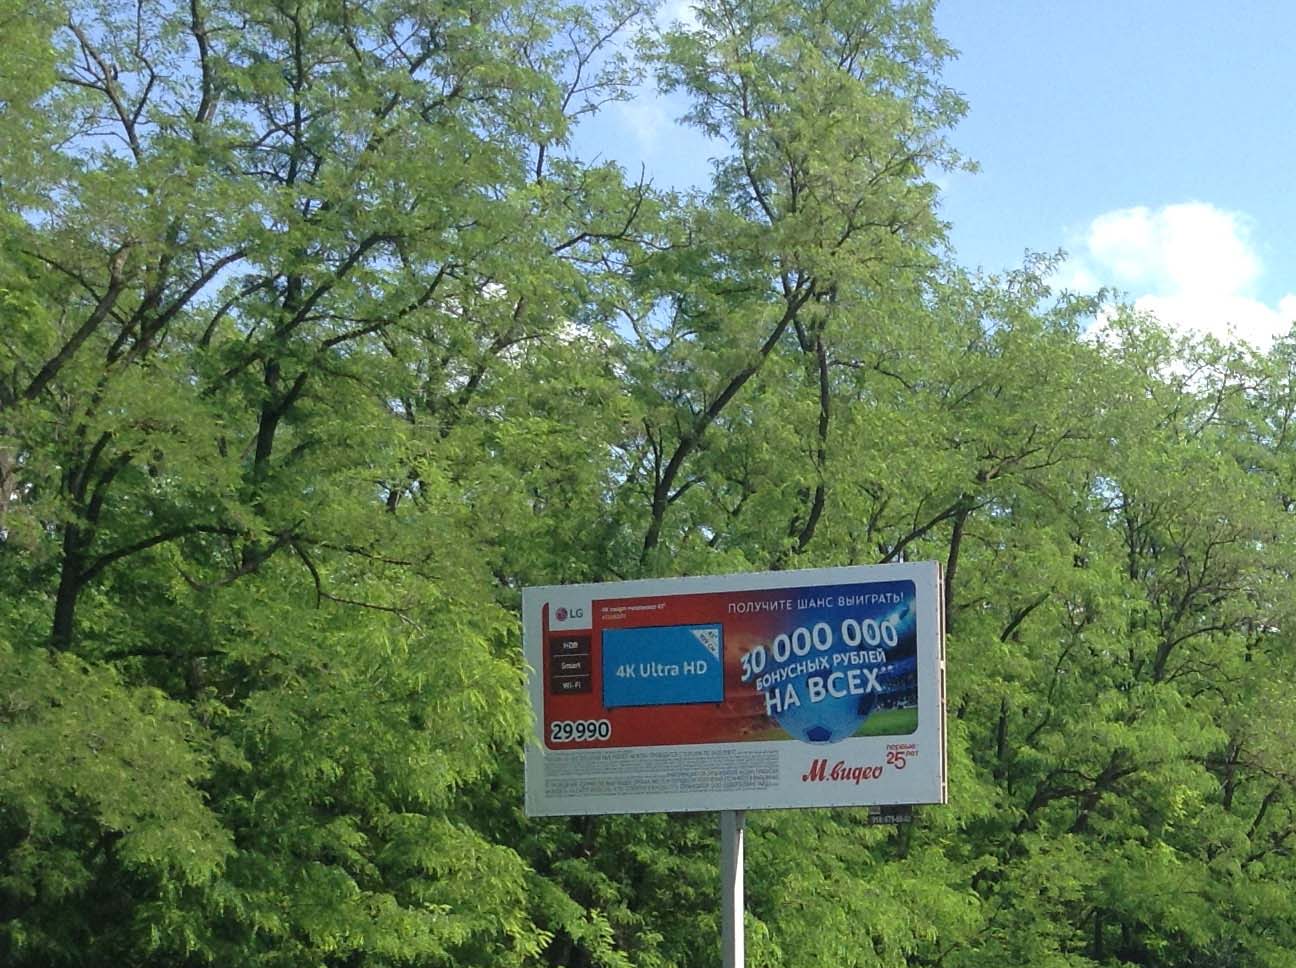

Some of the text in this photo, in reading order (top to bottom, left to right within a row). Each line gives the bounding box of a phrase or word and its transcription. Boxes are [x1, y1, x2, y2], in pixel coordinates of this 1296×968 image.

[728, 591, 904, 614] ПОЛУЧИТЕ ШАНС ВЫИГРАТЬ!
[569, 608, 584, 619] LG
[740, 618, 899, 682] 30 000 000
[561, 661, 581, 670] Smart
[616, 659, 708, 679] 4K Ultra HD
[755, 647, 887, 691] БОНУСНЫХ РУБЛЕЙ
[562, 681, 581, 690] Wi-Fi
[764, 684, 801, 716] НА
[886, 750, 906, 770] 25
